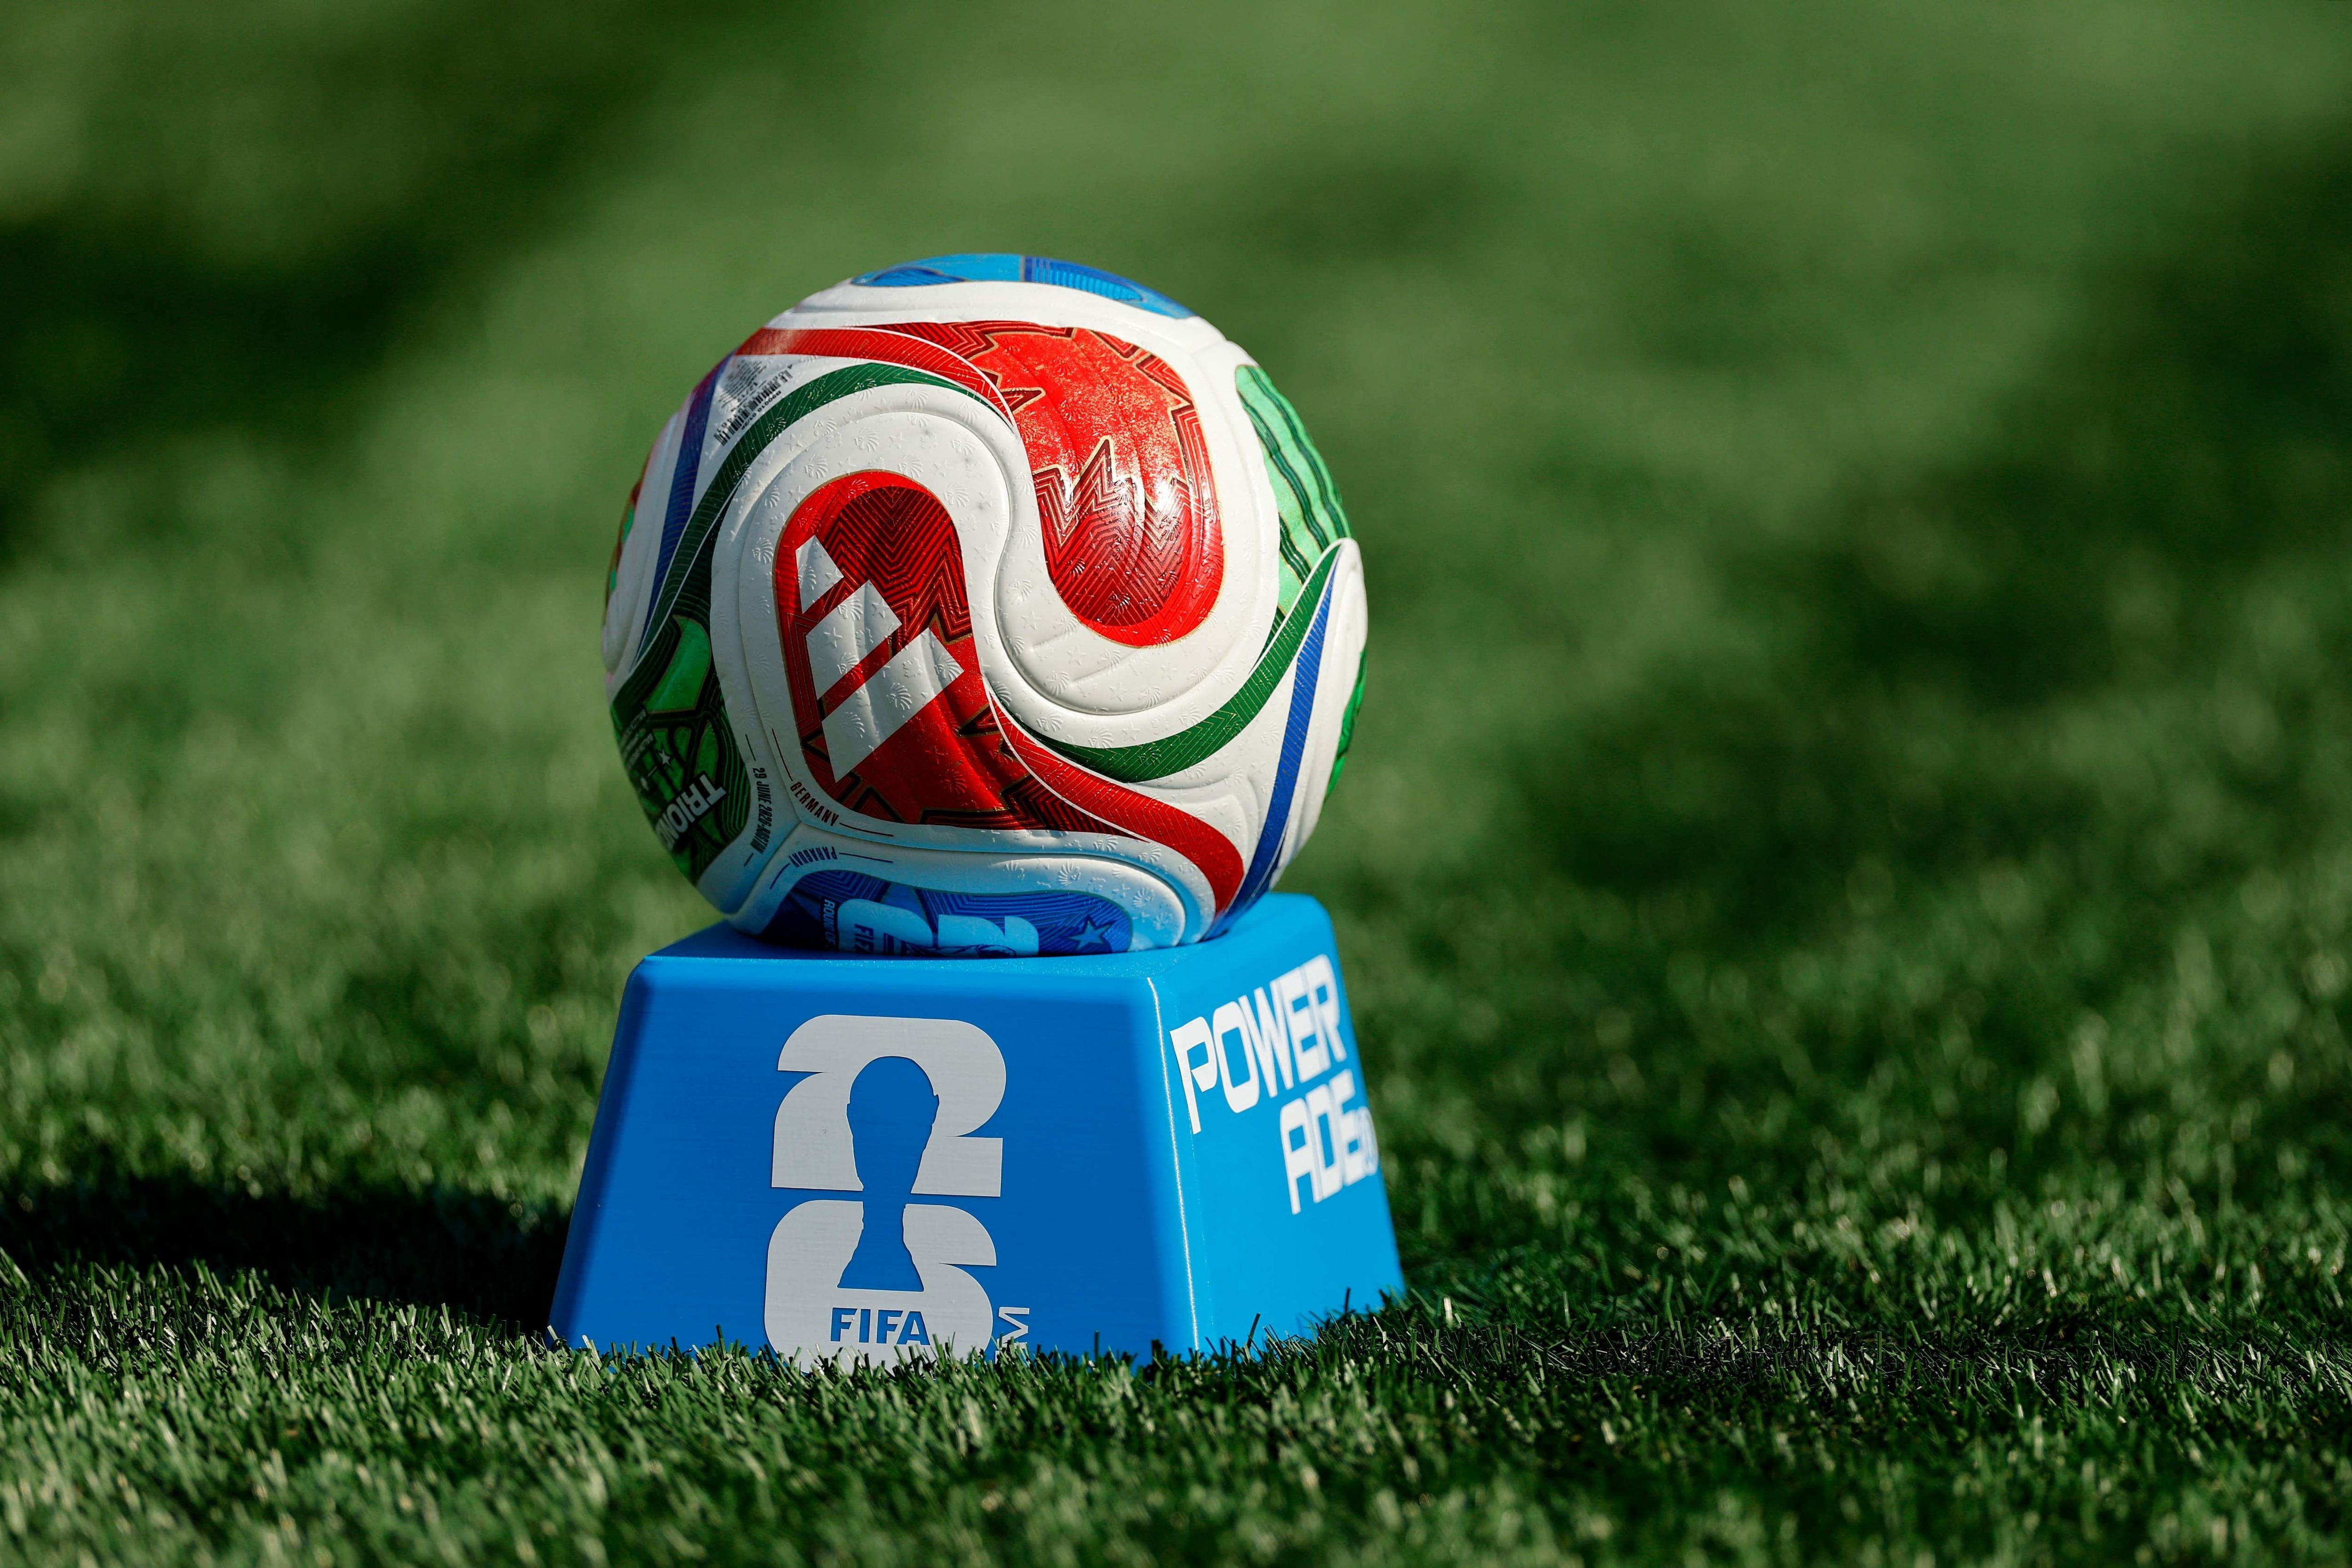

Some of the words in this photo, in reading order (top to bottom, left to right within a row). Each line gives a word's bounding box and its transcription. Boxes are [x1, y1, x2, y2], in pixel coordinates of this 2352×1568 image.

[753, 767, 767, 779] 29
[756, 781, 772, 805] JUNE
[790, 781, 840, 827] GERMANY
[788, 846, 838, 868] PARAGUAY
[1169, 954, 1346, 1135] POWER
[830, 1307, 931, 1346] FIFA
